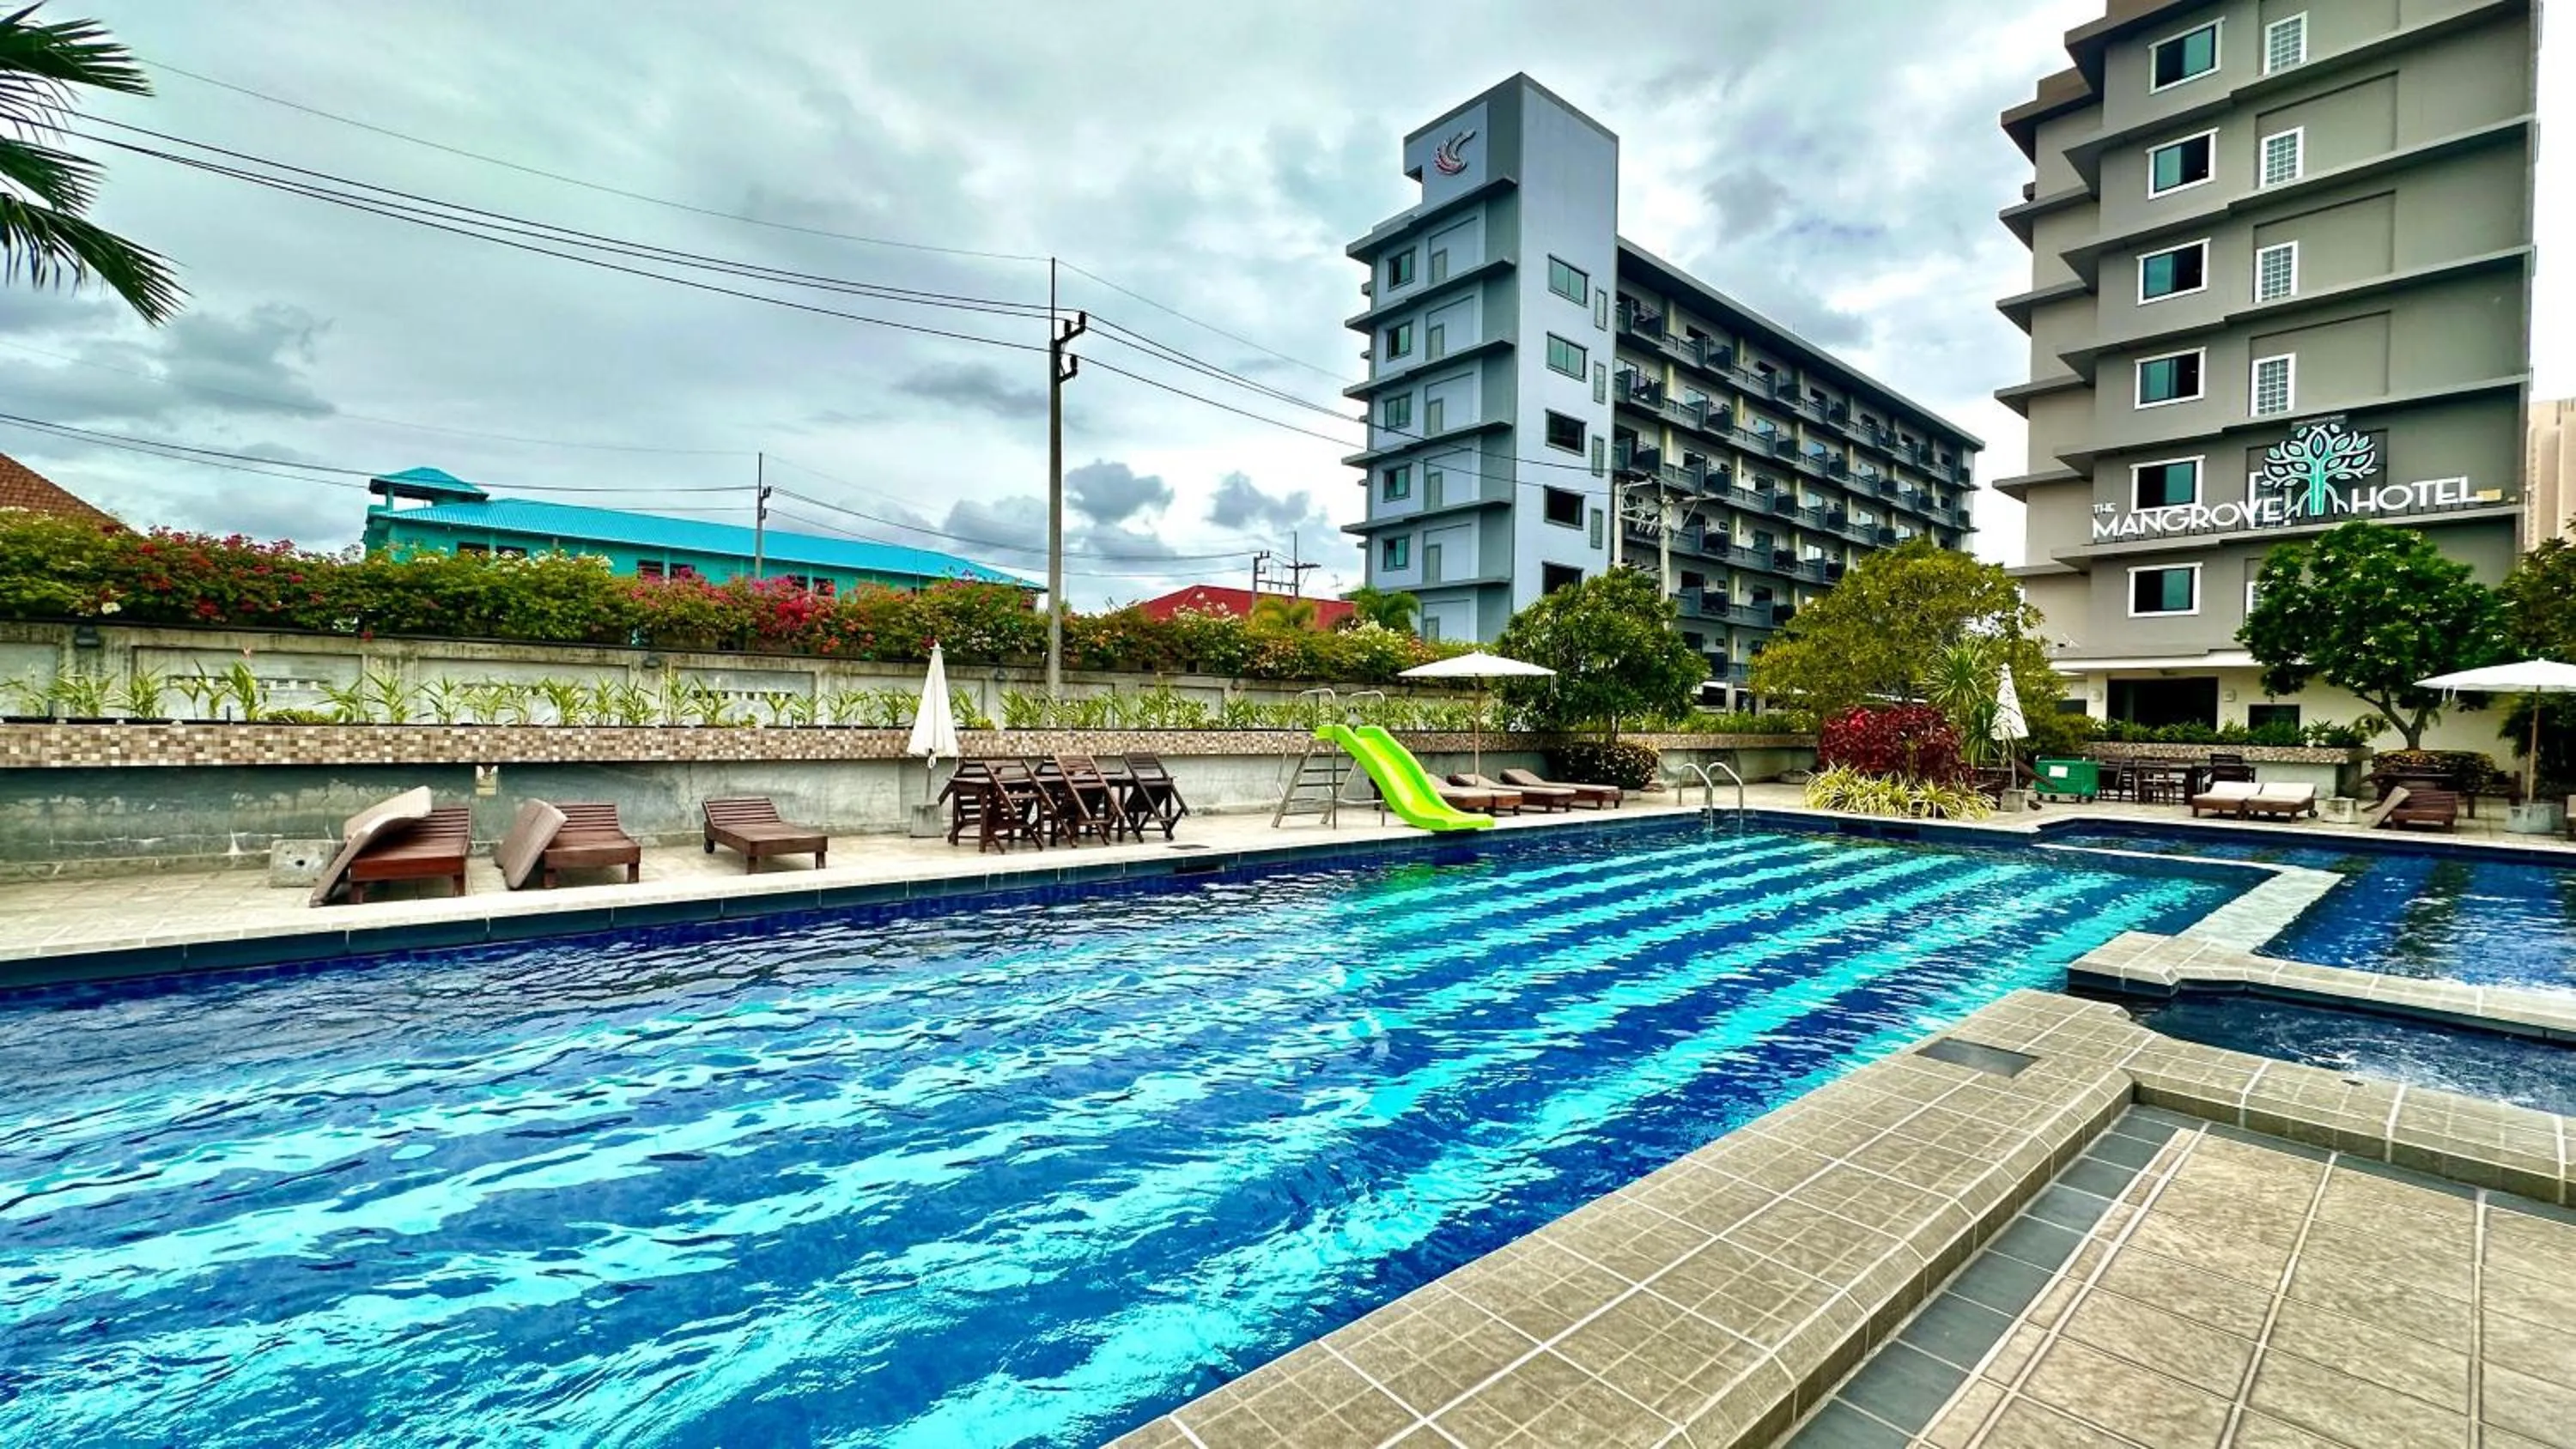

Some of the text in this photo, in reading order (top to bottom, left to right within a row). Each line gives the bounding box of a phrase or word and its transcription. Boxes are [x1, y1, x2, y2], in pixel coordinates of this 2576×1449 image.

[2093, 476, 2484, 538] MANGROVE HOTEL
[2093, 502, 2117, 514] THE
